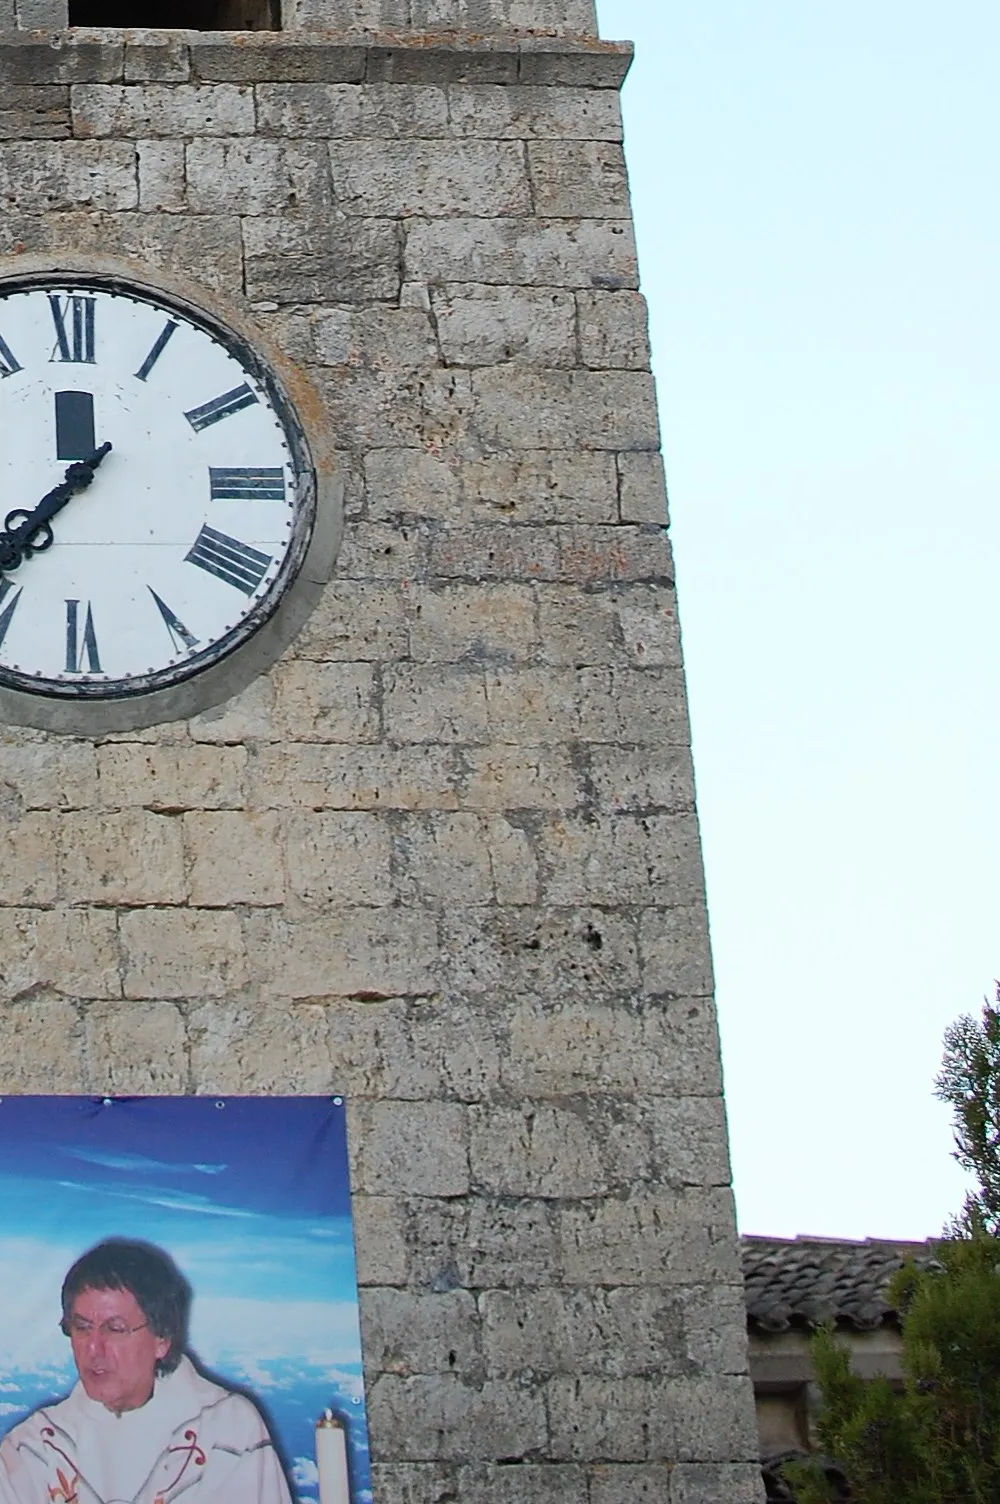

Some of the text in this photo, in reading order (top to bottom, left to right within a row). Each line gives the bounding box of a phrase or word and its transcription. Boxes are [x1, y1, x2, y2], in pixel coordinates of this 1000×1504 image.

[47, 294, 96, 364] XII
[134, 318, 179, 381] I
[183, 381, 260, 433] II
[208, 466, 286, 502] III
[185, 524, 273, 597] IIII
[63, 599, 103, 674] VI
[146, 584, 200, 655] V
